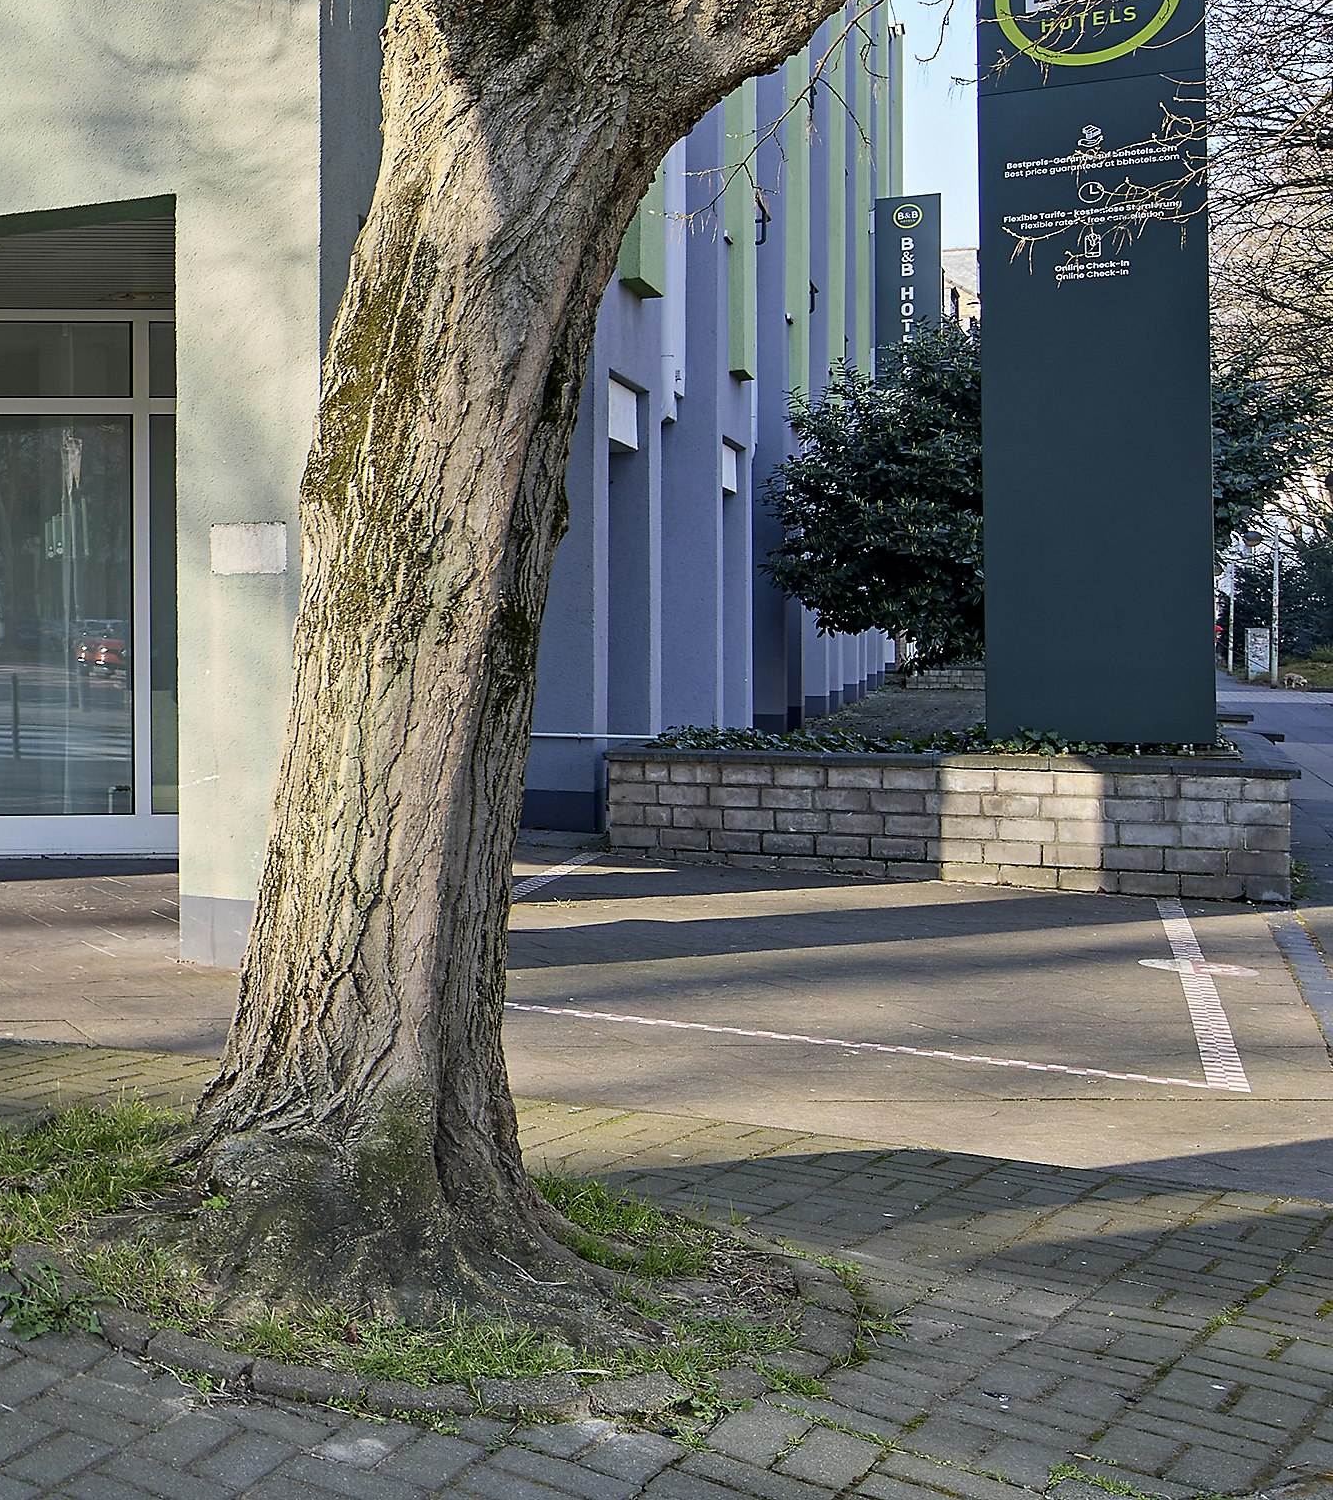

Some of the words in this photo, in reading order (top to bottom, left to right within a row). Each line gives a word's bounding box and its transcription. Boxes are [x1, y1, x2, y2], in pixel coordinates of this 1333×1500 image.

[1004, 170, 1024, 179] Best
[1025, 167, 1048, 178] price
[897, 210, 919, 220] B&B
[1003, 213, 1039, 223] Flexible
[1039, 210, 1066, 220] Tarife
[1020, 220, 1054, 230] Flexible
[900, 236, 915, 277] B&B
[1054, 262, 1085, 272] Online
[1055, 271, 1085, 281] Online
